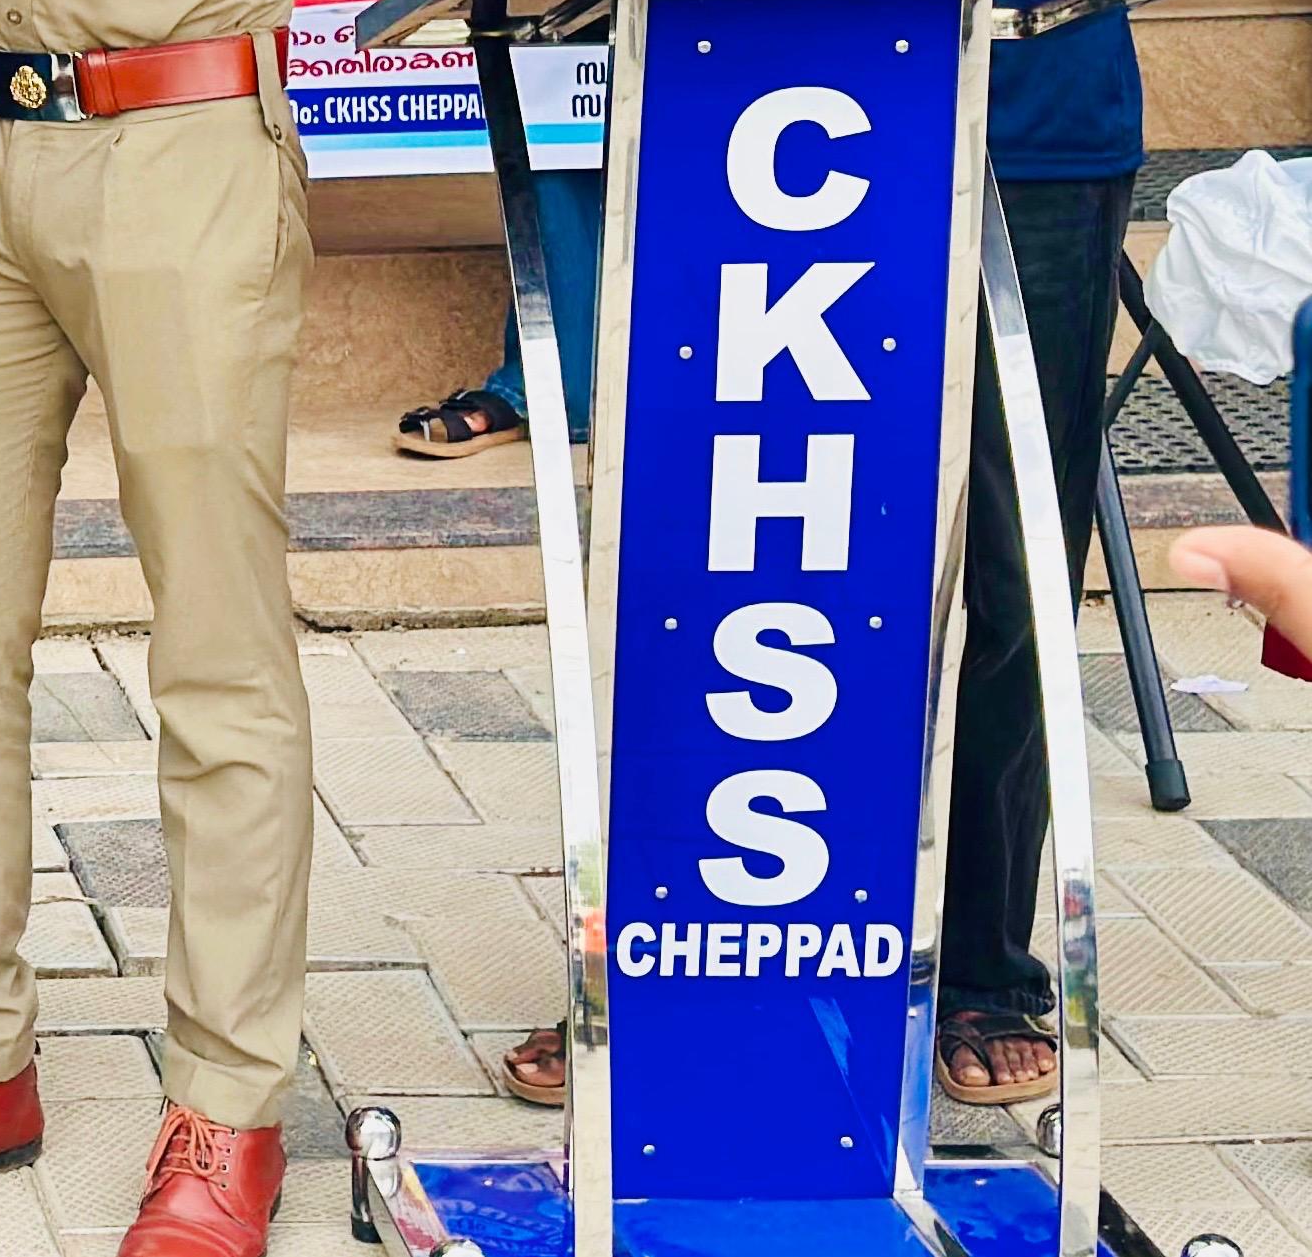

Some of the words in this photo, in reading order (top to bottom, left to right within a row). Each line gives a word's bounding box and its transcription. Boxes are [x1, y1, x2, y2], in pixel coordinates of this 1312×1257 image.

[324, 94, 392, 124] CKHSS
[397, 92, 487, 122] CHEPPA
[697, 85, 876, 907] CKHSS
[616, 921, 904, 978] CHEPPAD
